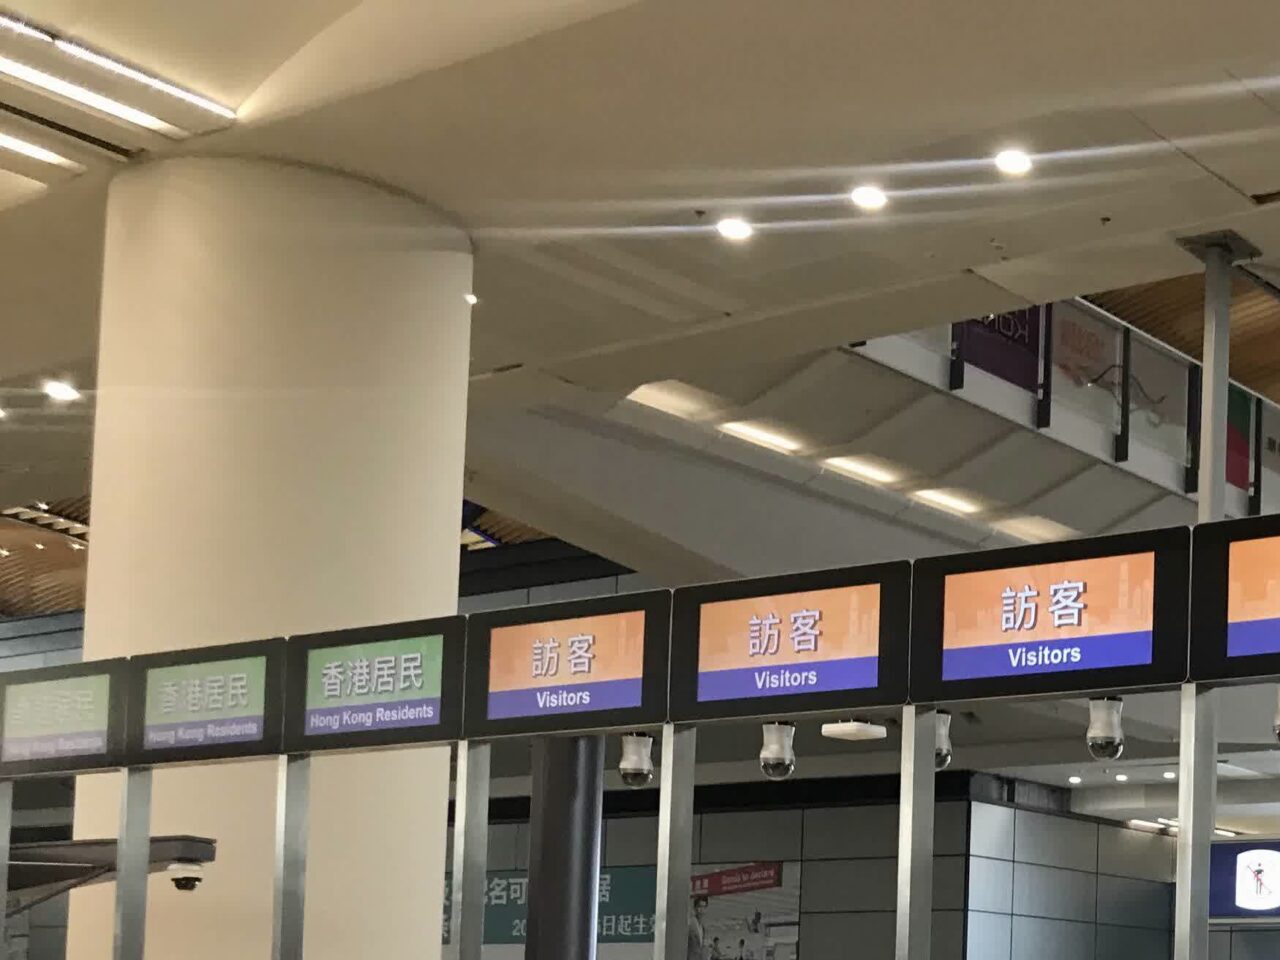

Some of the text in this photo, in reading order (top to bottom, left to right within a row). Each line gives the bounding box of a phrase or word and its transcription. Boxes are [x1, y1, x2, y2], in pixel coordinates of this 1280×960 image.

[1001, 580, 1087, 632] 訪客
[748, 609, 822, 657] 訪客
[322, 652, 424, 698] 香港居民
[532, 633, 597, 678] 訪客
[1008, 644, 1081, 667] Visitors
[159, 673, 248, 713] 香港居民
[537, 689, 590, 708] Visitors
[754, 670, 817, 689] Visitors
[310, 704, 434, 729] Hong Kong Residents
